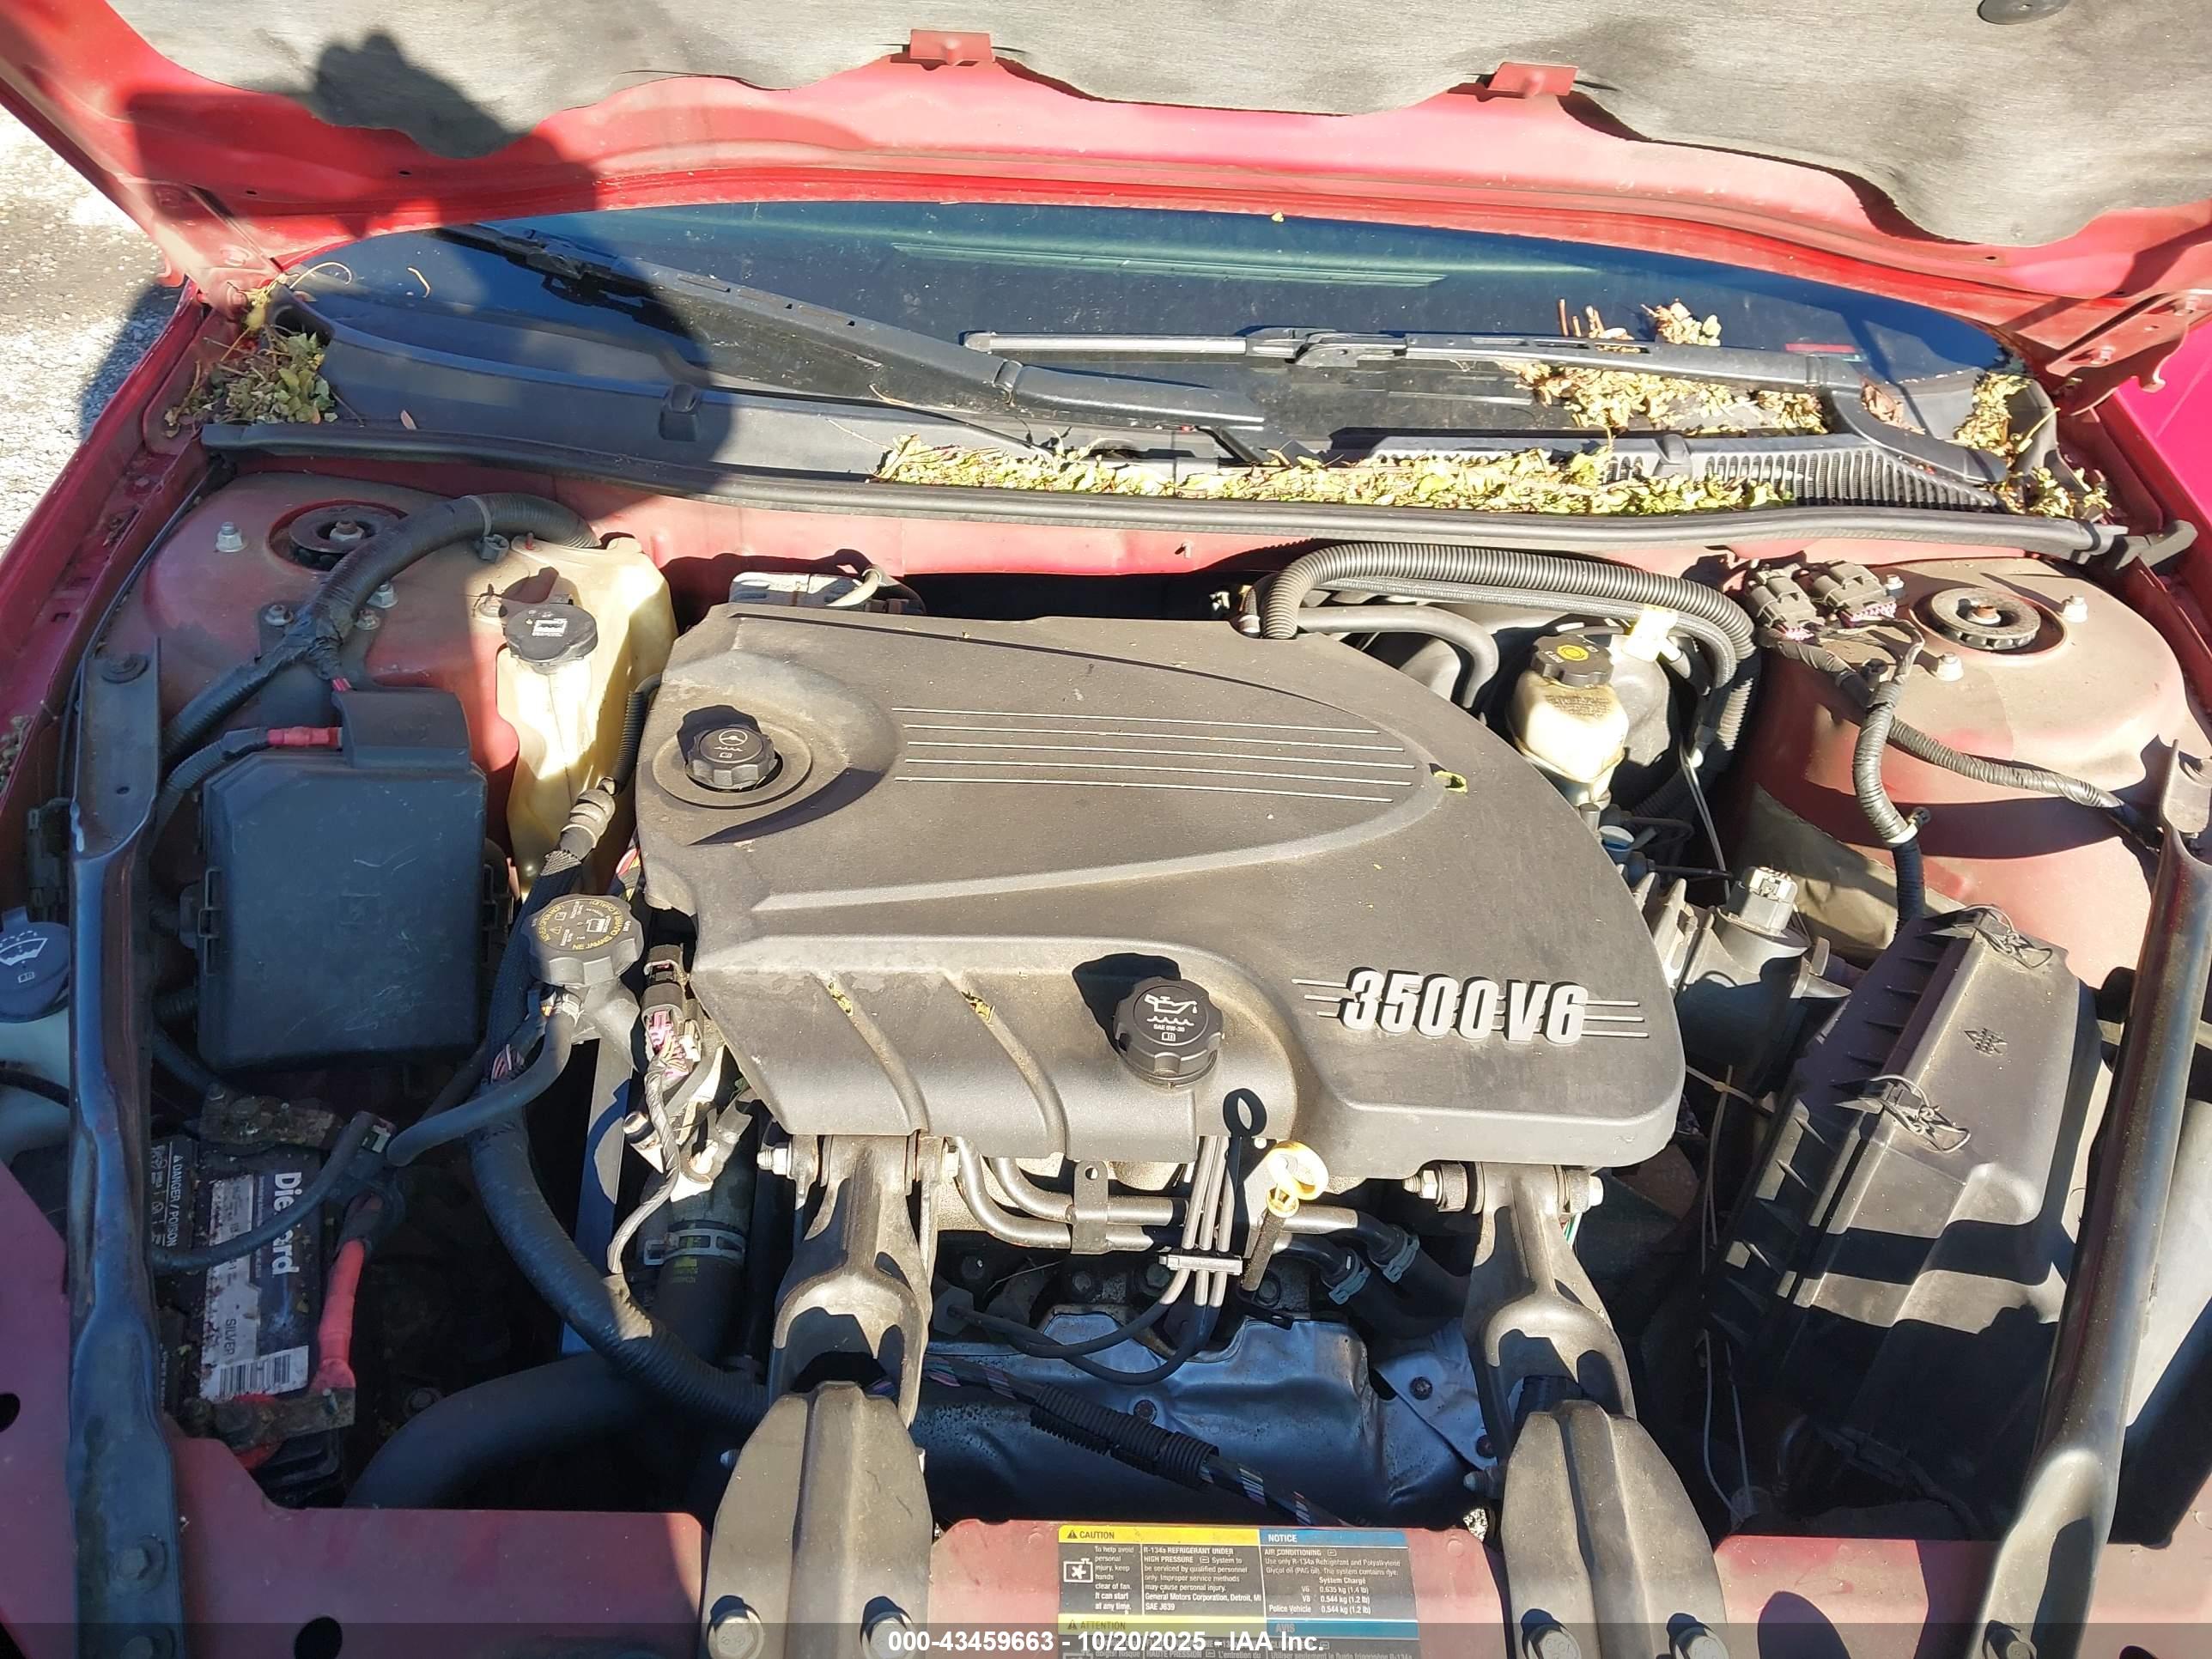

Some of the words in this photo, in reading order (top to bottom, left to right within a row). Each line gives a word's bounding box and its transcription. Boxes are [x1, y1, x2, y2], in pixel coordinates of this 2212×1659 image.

[170, 1164, 183, 1203] DANGER
[270, 1171, 301, 1275] Dieard
[166, 1212, 179, 1247] POISON
[224, 1318, 237, 1356] SILVER
[1268, 1534, 1297, 1543] NOTICE
[1339, 1595, 1347, 1604] kg
[1289, 1605, 1311, 1613] Vehicle
[1080, 1621, 1126, 1630] ATTENTION
[1275, 1623, 1296, 1632] AVIS
